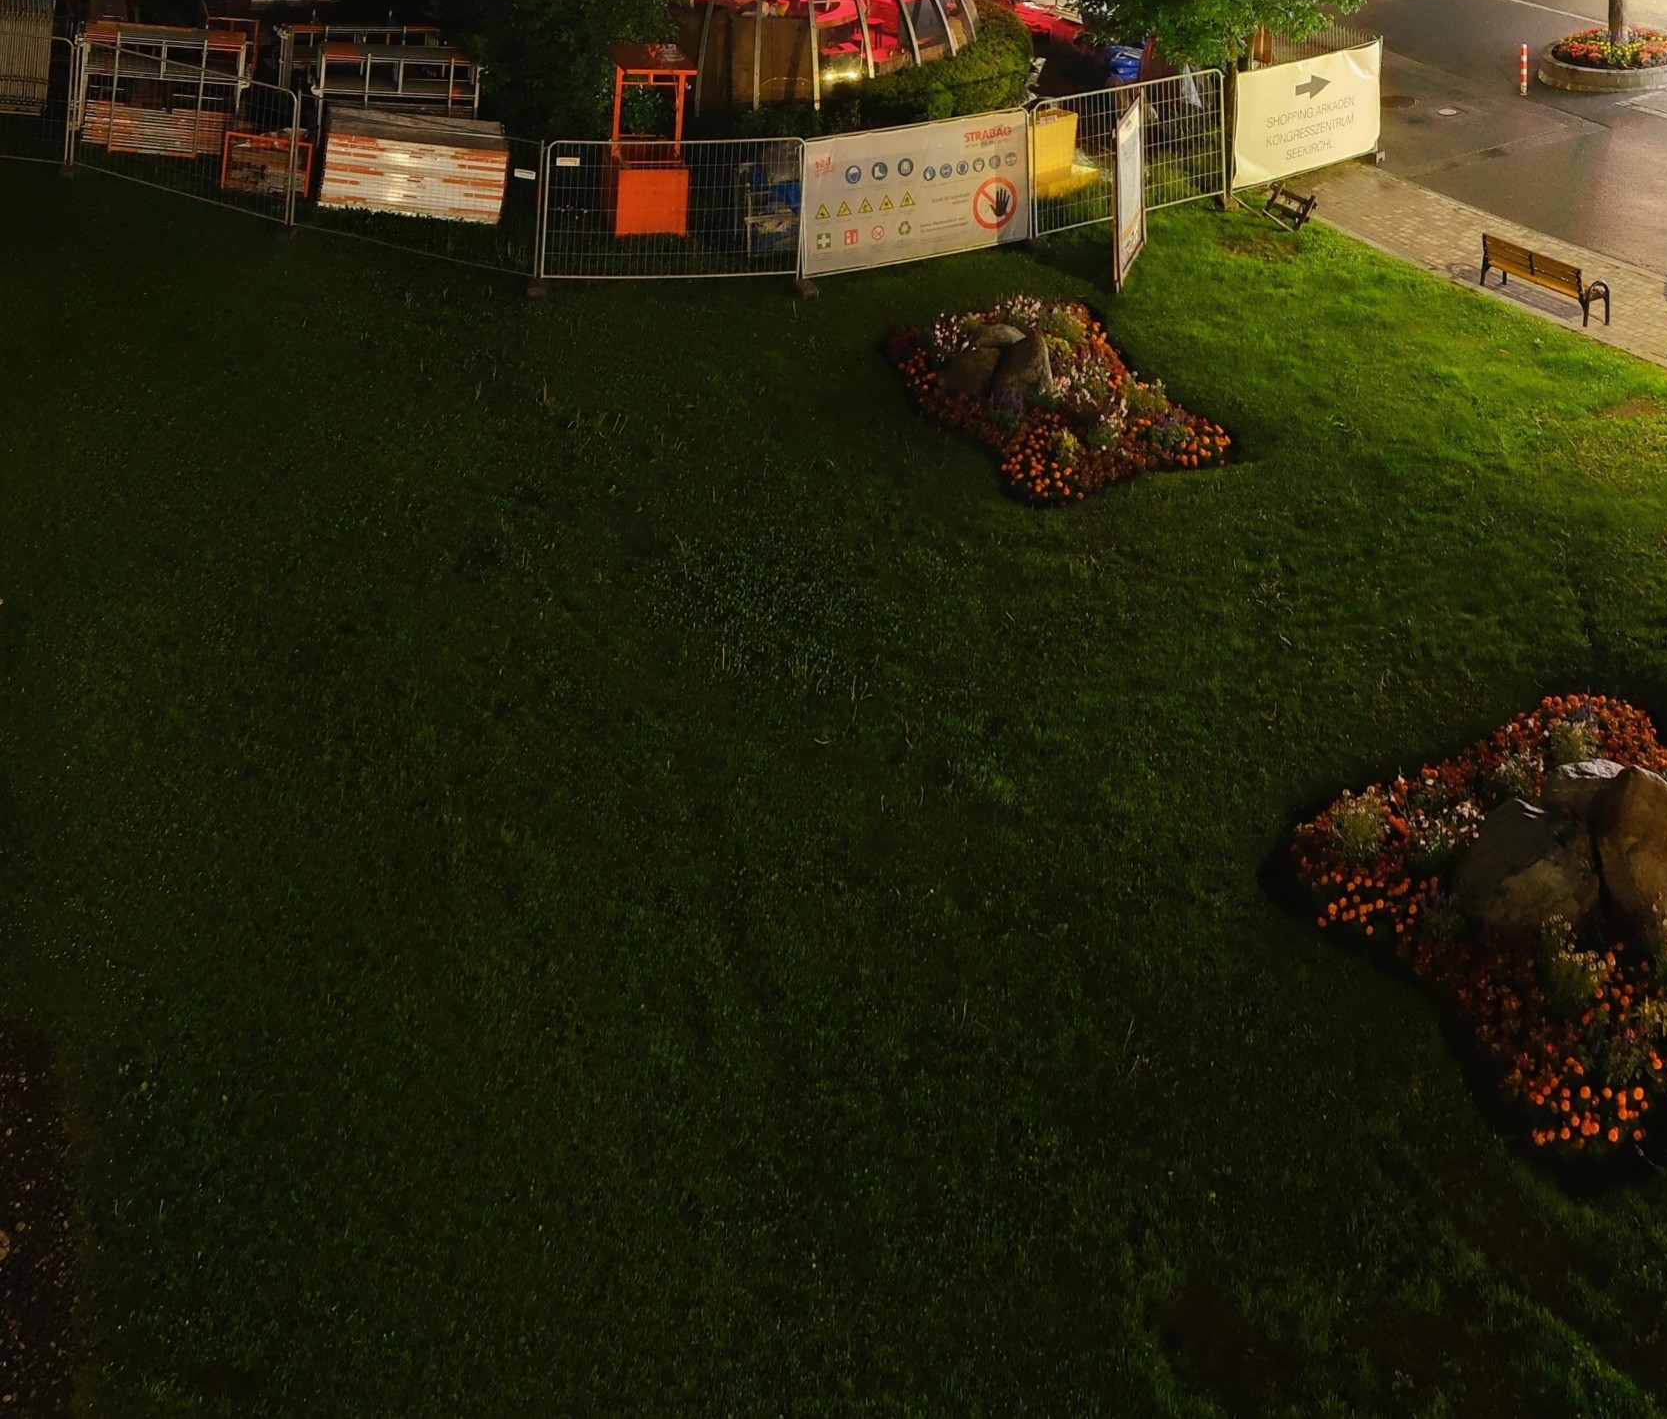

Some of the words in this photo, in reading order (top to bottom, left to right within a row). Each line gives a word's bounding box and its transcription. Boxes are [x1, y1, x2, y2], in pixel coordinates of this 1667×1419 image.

[1267, 107, 1314, 129] SHOPPING
[1315, 96, 1355, 116] ARKADEN
[964, 126, 1013, 144] STRABAG
[1266, 114, 1355, 148] KONGRESSZENTRUM
[1286, 139, 1334, 161] SEEKIRCHL
